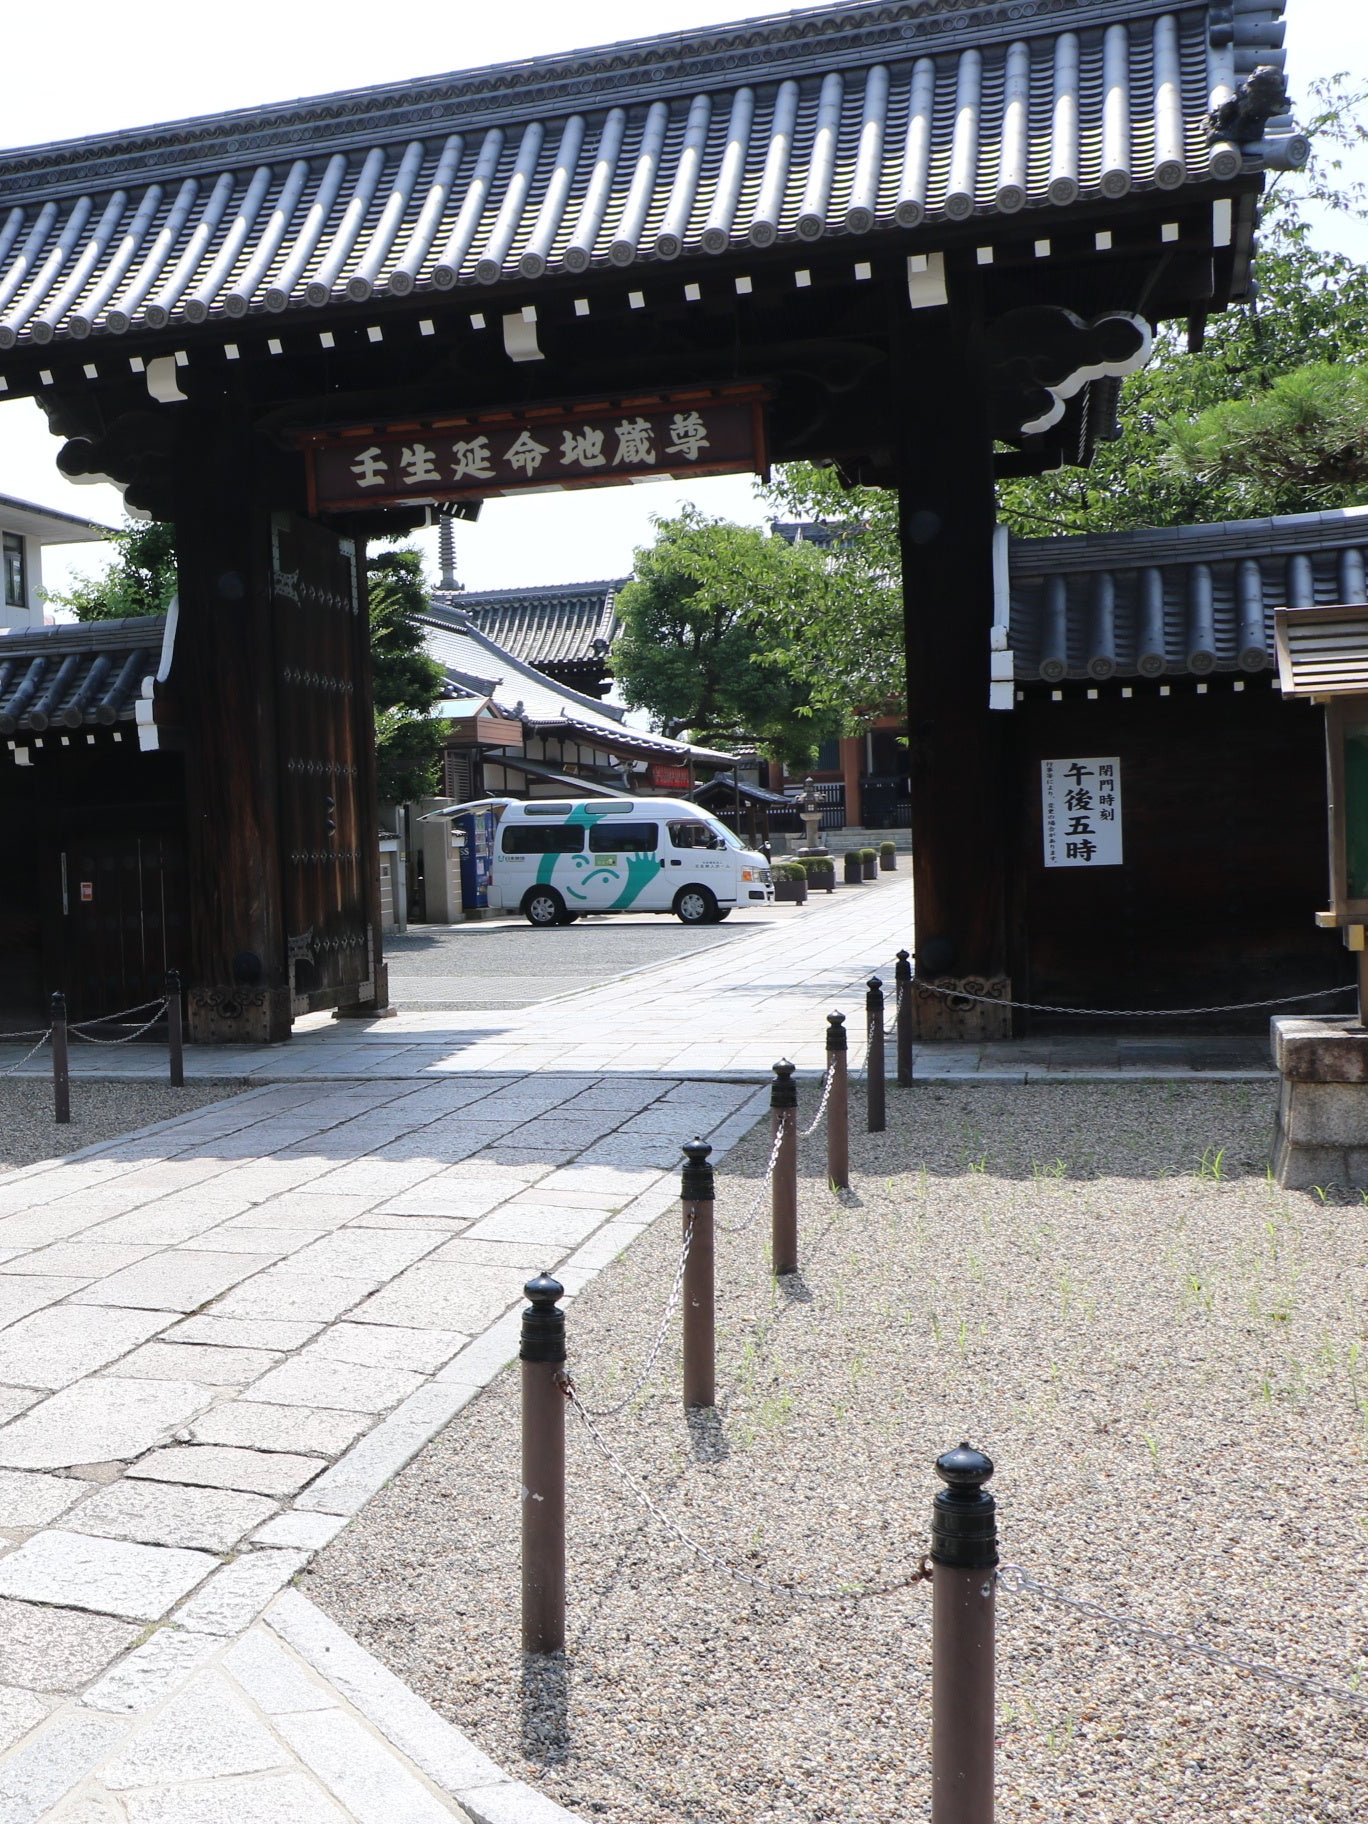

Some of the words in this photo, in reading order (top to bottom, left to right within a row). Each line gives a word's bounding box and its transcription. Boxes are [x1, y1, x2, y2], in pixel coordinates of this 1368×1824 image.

[350, 411, 711, 488] 壬生延命地蔵尊
[1063, 763, 1097, 862] 午後五時
[1099, 765, 1115, 821] 閉門時刻
